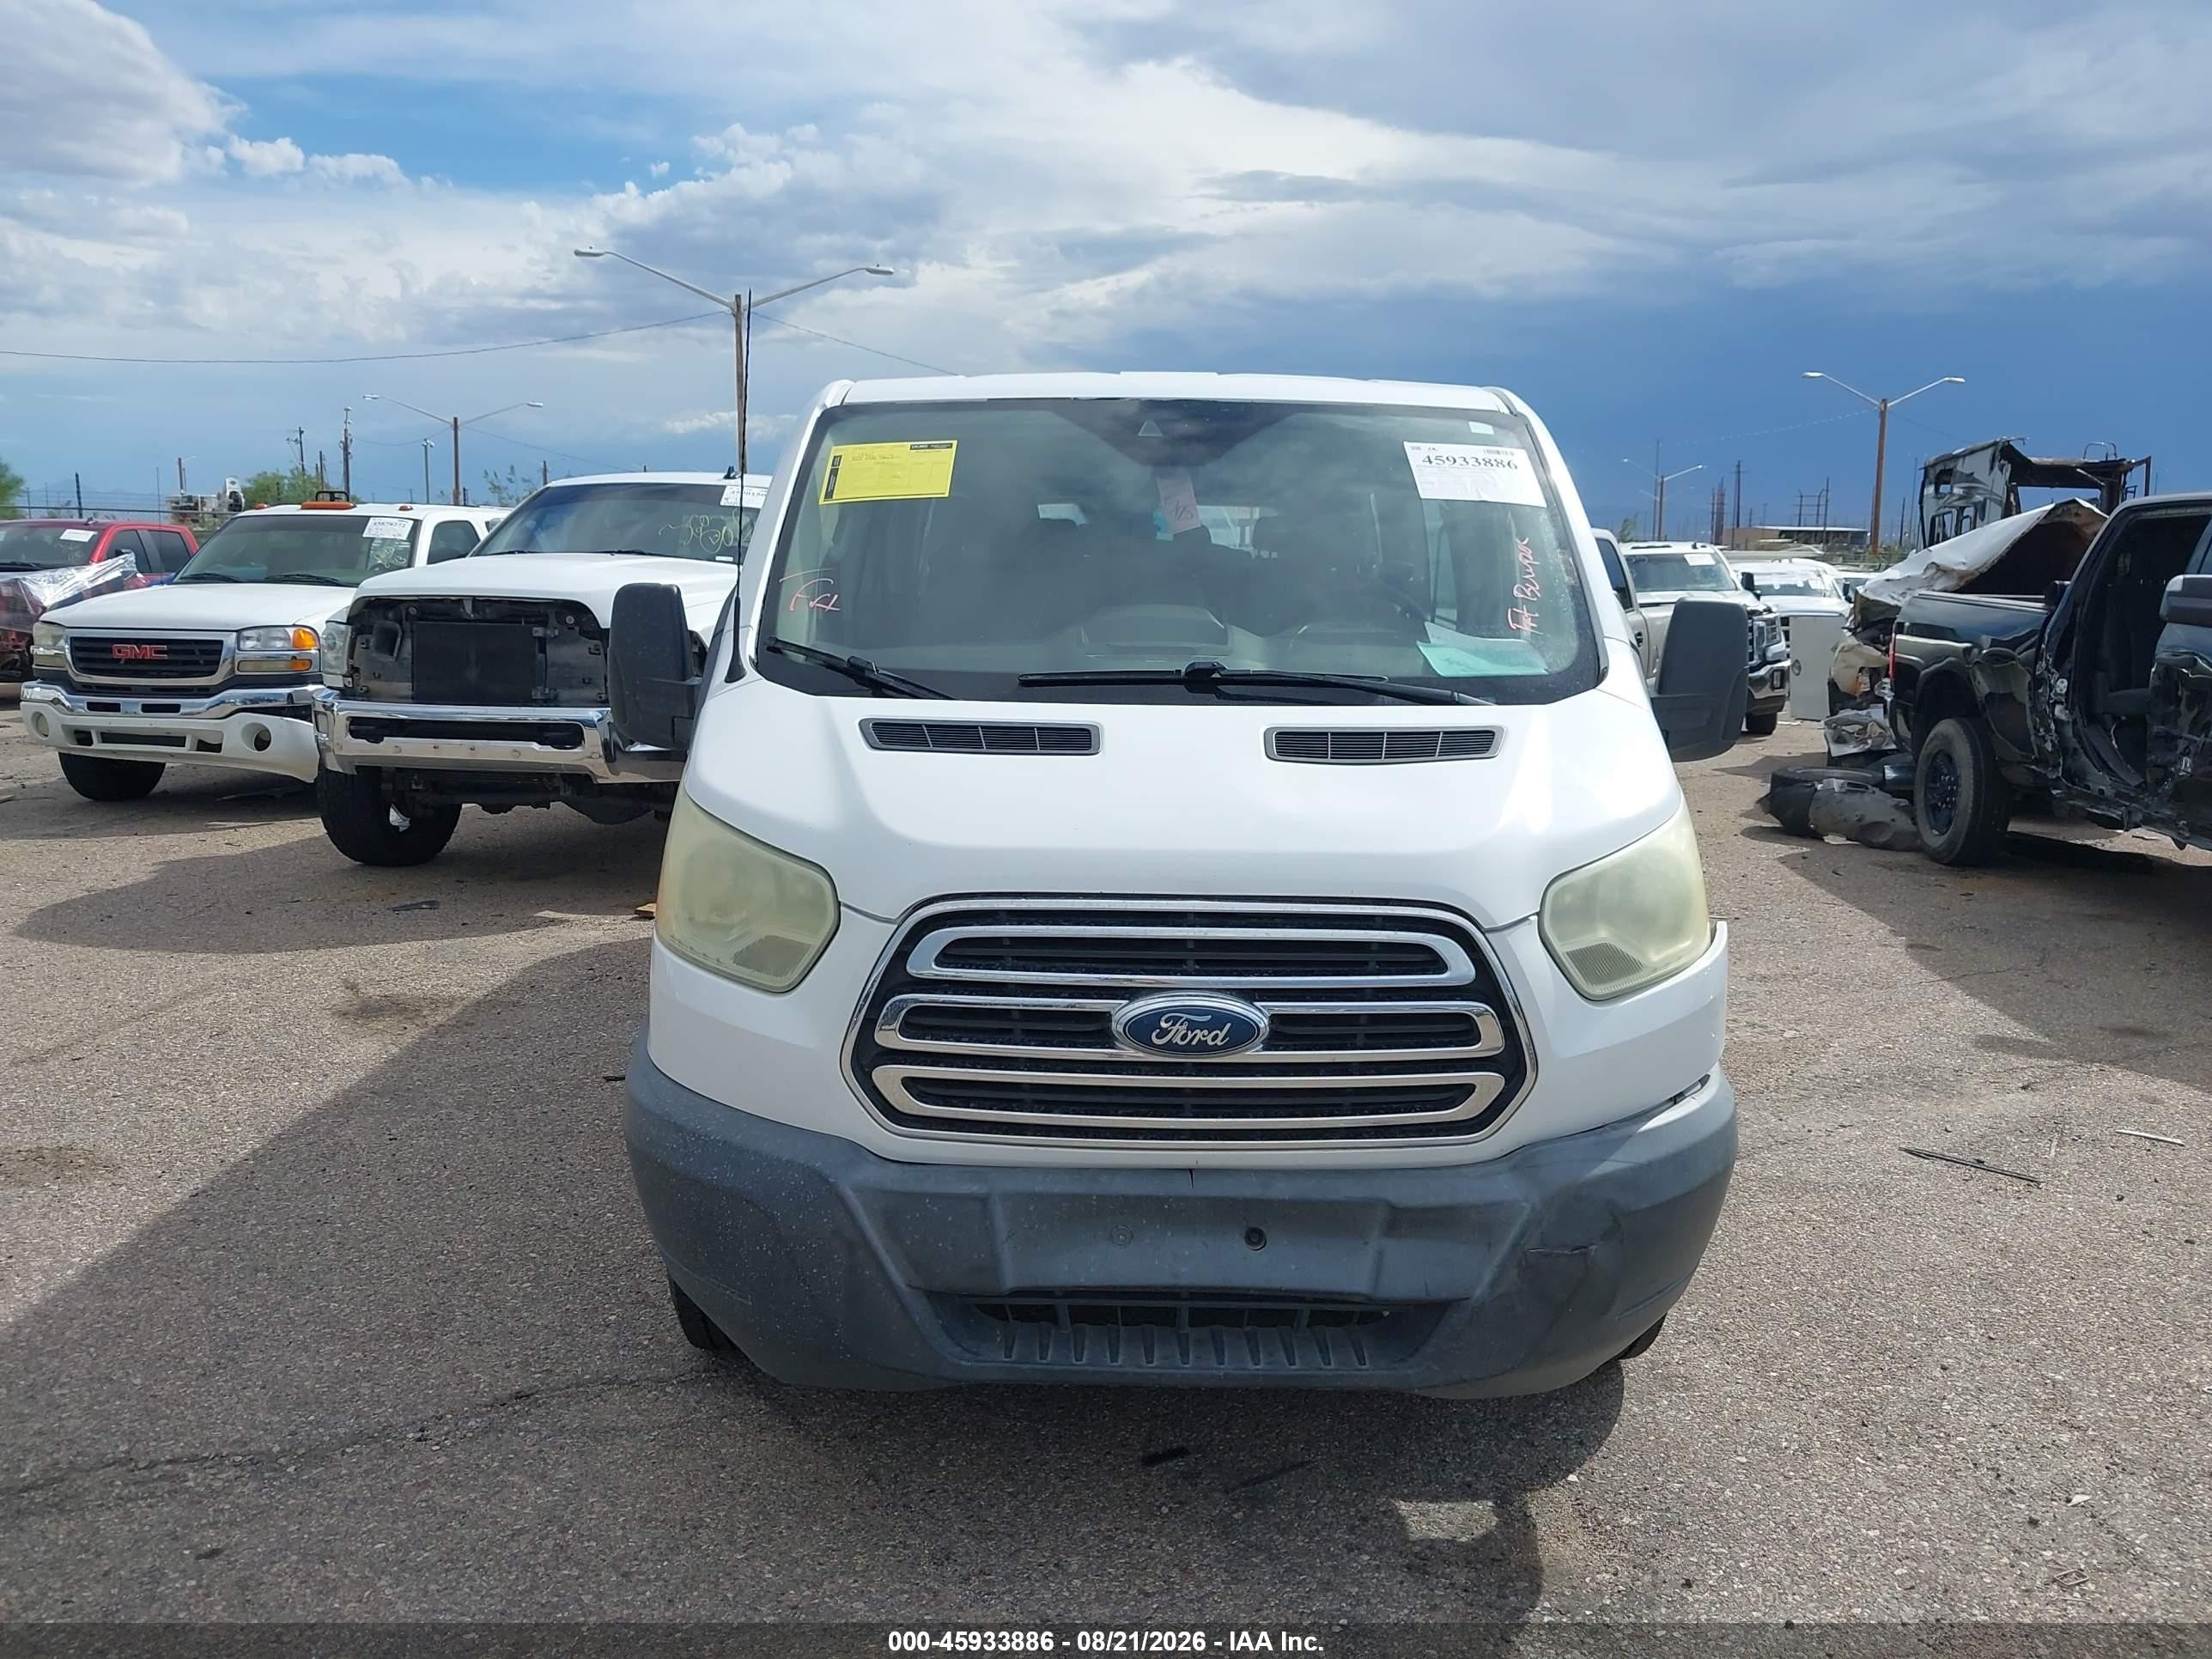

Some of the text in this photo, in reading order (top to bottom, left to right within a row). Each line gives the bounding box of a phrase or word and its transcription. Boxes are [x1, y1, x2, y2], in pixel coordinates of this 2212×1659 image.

[1421, 455, 1519, 471] 45933886
[112, 645, 168, 659] GMC
[1152, 1012, 1230, 1046] Ford
